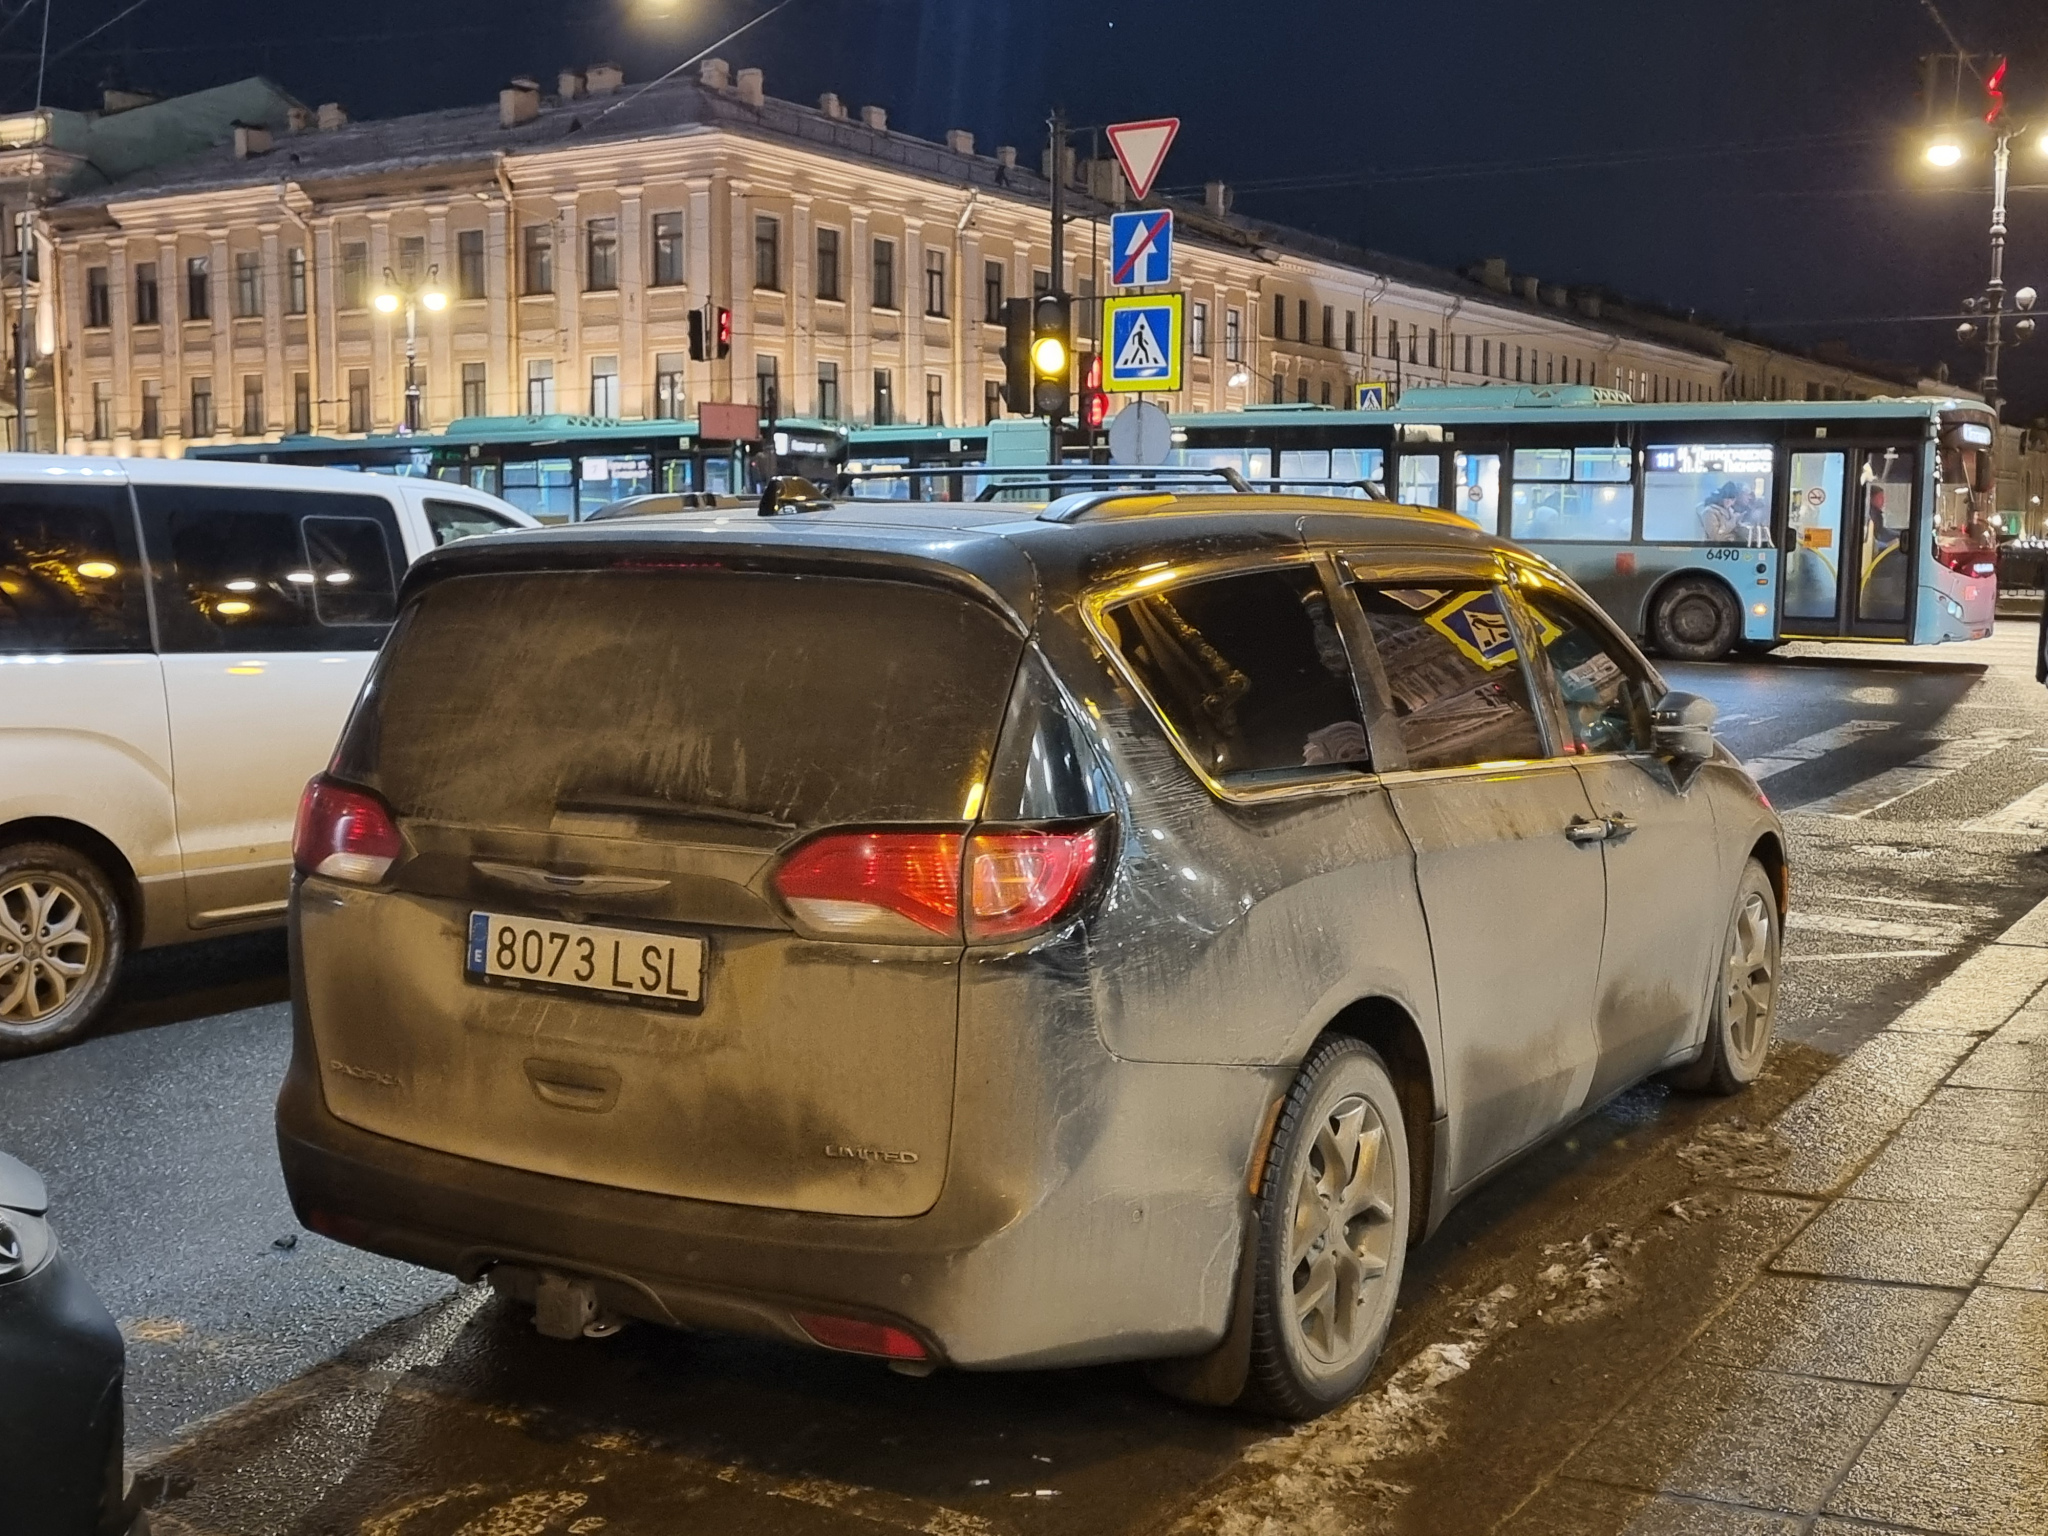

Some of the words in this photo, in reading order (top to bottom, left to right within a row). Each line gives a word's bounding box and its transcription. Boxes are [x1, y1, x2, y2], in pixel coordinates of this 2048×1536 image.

[1706, 549, 1740, 561] 6490
[474, 949, 482, 963] E
[496, 926, 595, 982] 8073
[611, 940, 689, 996] LSL
[824, 1144, 919, 1164] LIMITED
